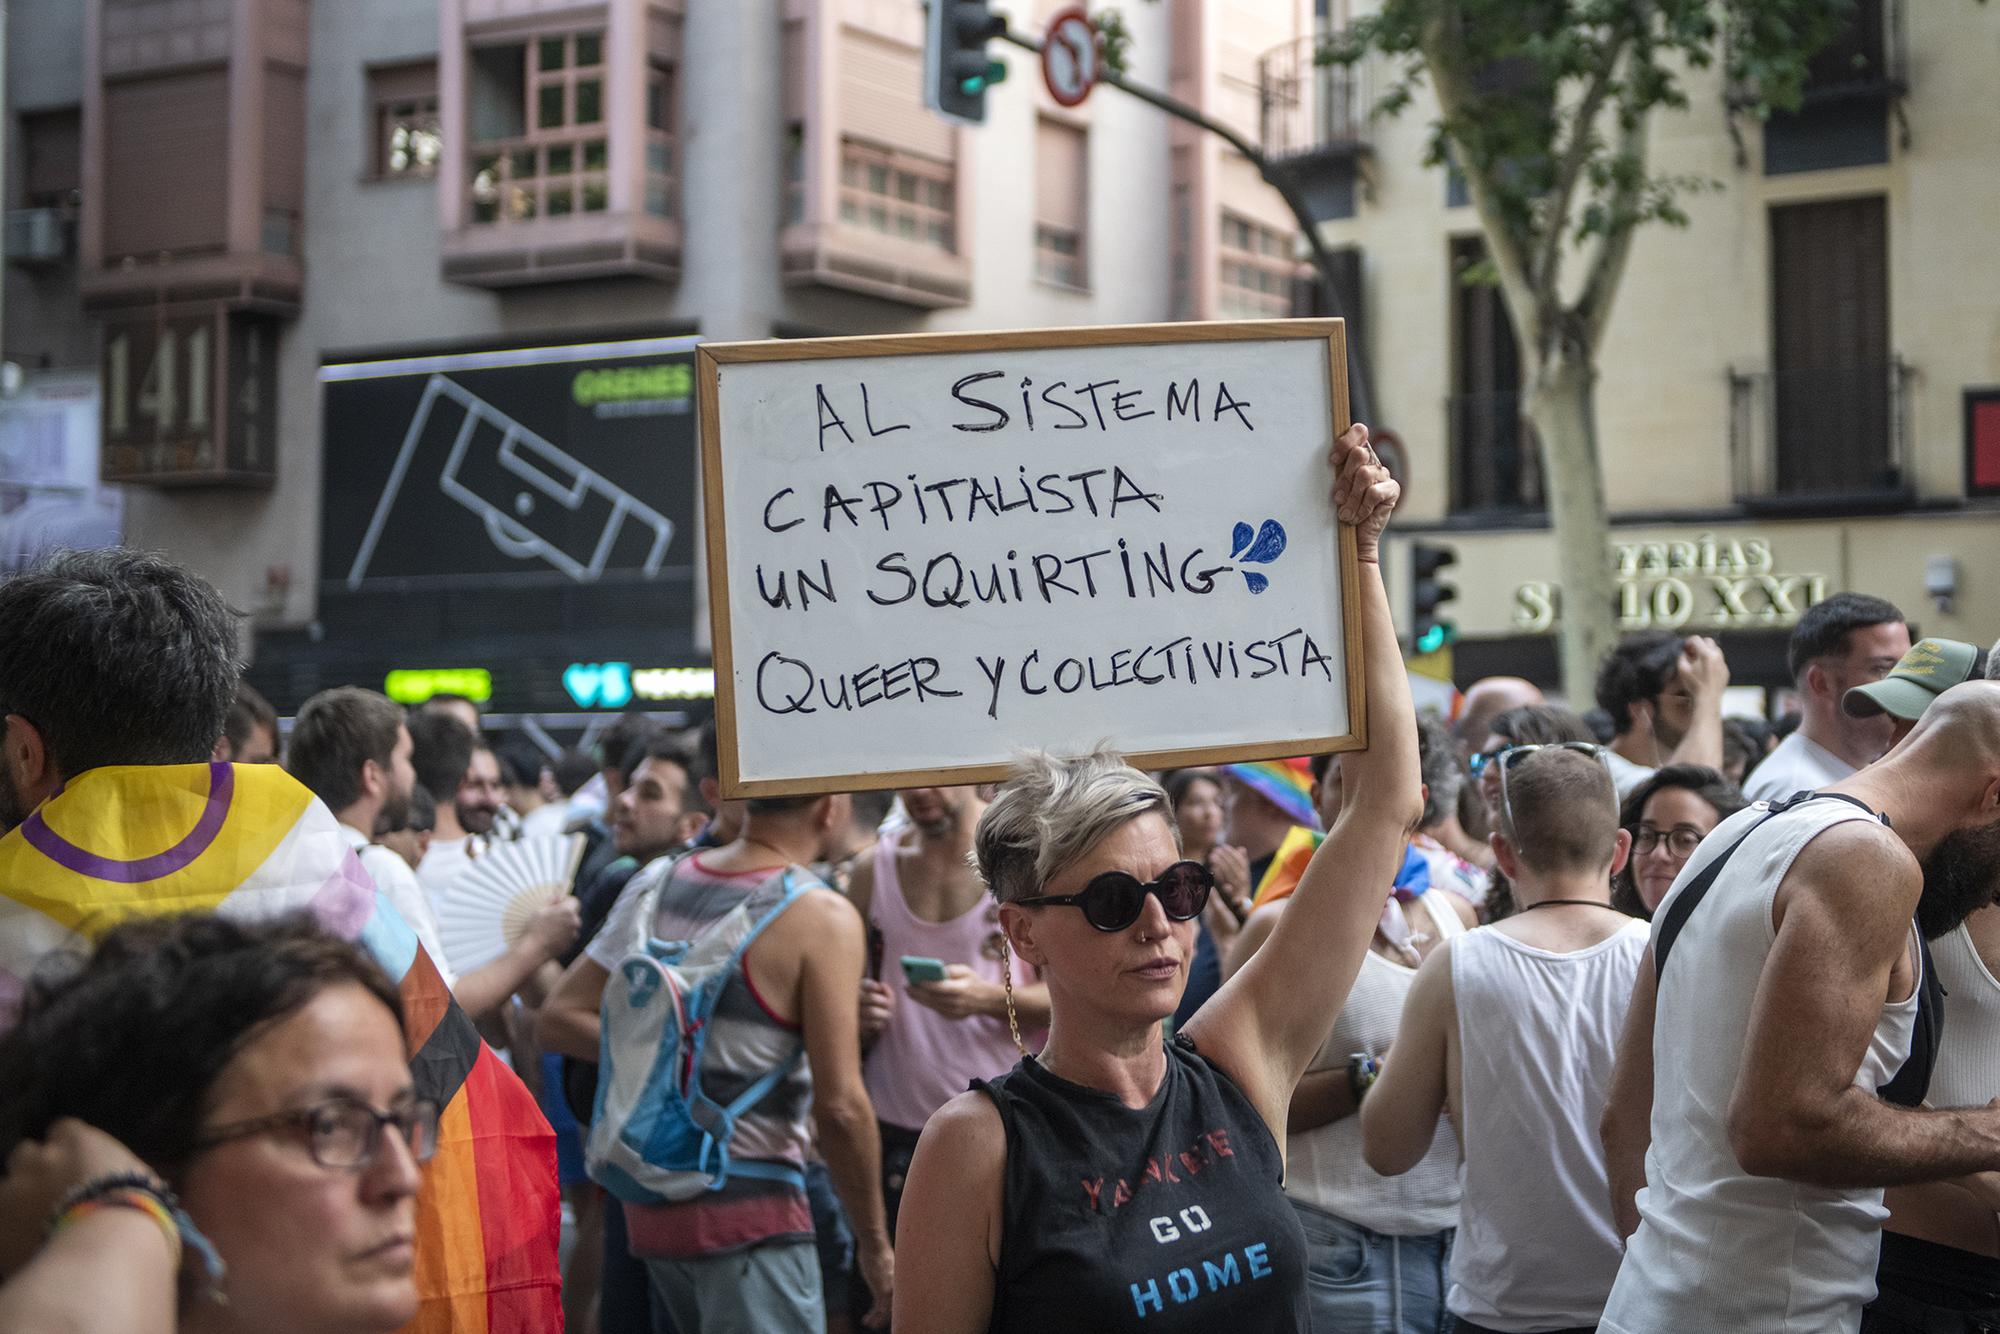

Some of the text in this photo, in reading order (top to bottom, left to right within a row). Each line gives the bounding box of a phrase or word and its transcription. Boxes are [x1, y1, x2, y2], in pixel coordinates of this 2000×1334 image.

[815, 381, 911, 452] AL
[755, 559, 838, 611] UN
[1514, 577, 1695, 633] SLO
[755, 650, 964, 716] QUEER
[976, 656, 1006, 720] Y
[1149, 1204, 1213, 1245] GO
[1129, 1242, 1273, 1319] HOME
